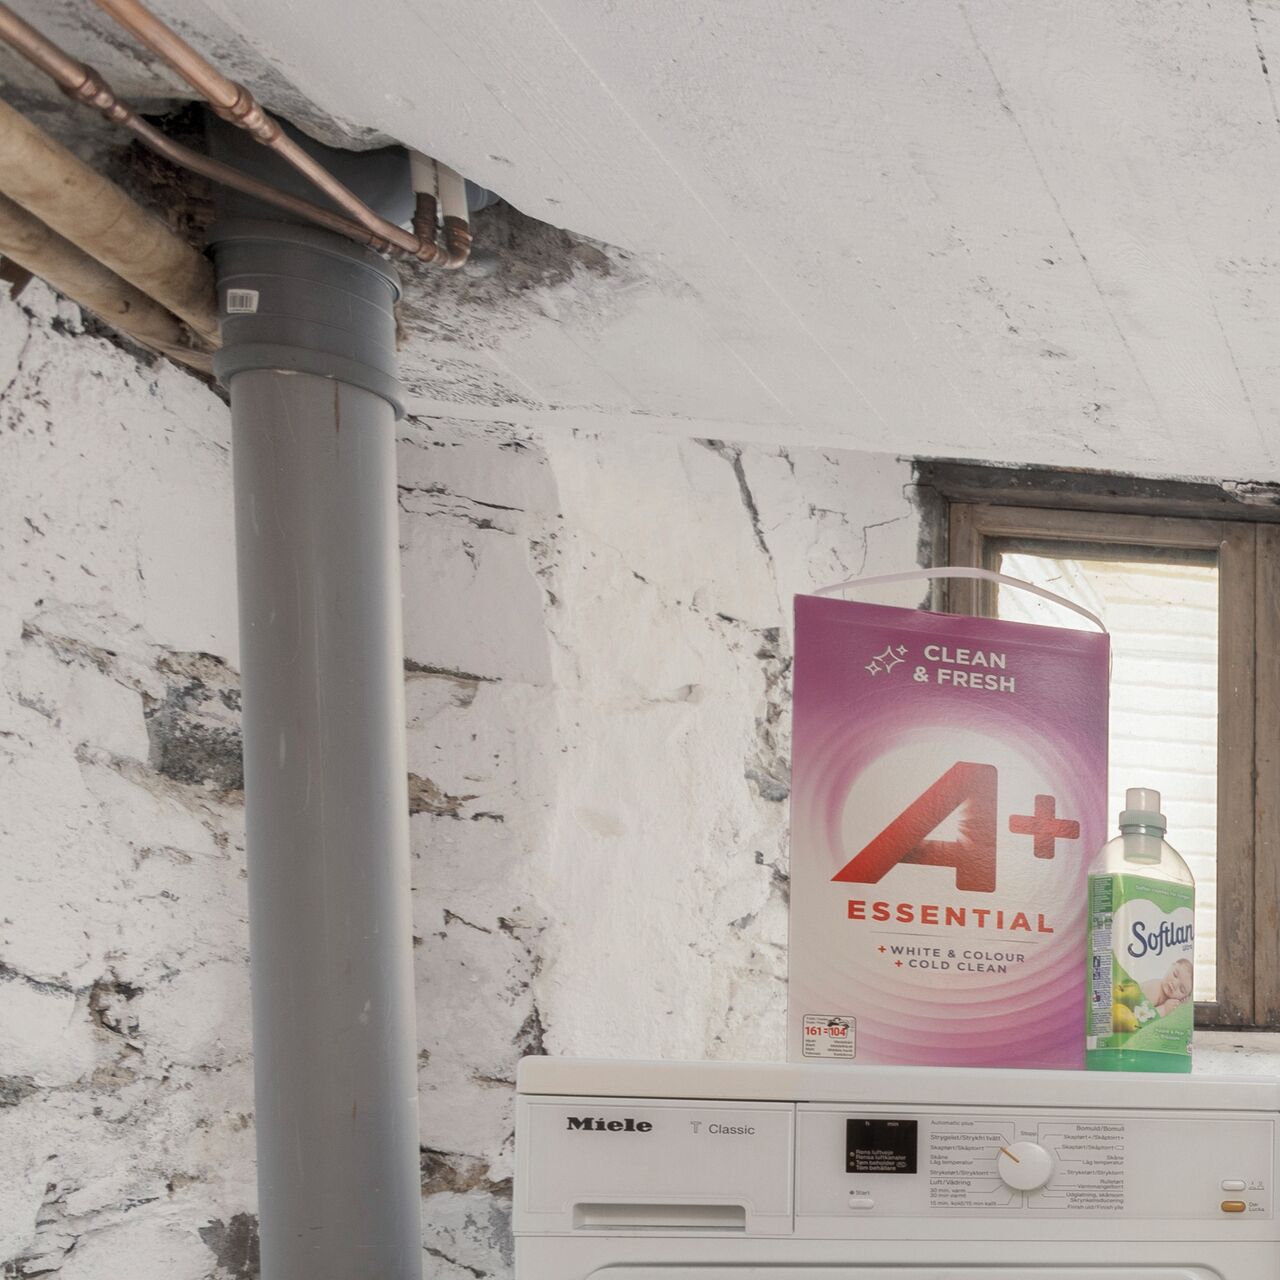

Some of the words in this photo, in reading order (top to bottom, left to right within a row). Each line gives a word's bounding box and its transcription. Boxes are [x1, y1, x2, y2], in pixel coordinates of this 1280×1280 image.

[924, 645, 1006, 669] CLEAN
[913, 666, 929, 682] &
[937, 668, 1015, 693] FRESH
[830, 761, 1080, 893] A+
[848, 900, 1054, 933] ESSENTIAL
[1128, 921, 1194, 958] Softlan
[890, 945, 941, 958] WHITE
[947, 949, 956, 959] &
[963, 950, 1025, 963] COLOUR
[908, 959, 950, 970] COLD
[957, 962, 1007, 973] CLEAN
[805, 1026, 821, 1036] 161
[830, 1027, 846, 1037] 104
[567, 1117, 653, 1132] Miele
[690, 1121, 702, 1134] T
[708, 1124, 755, 1135] Classic
